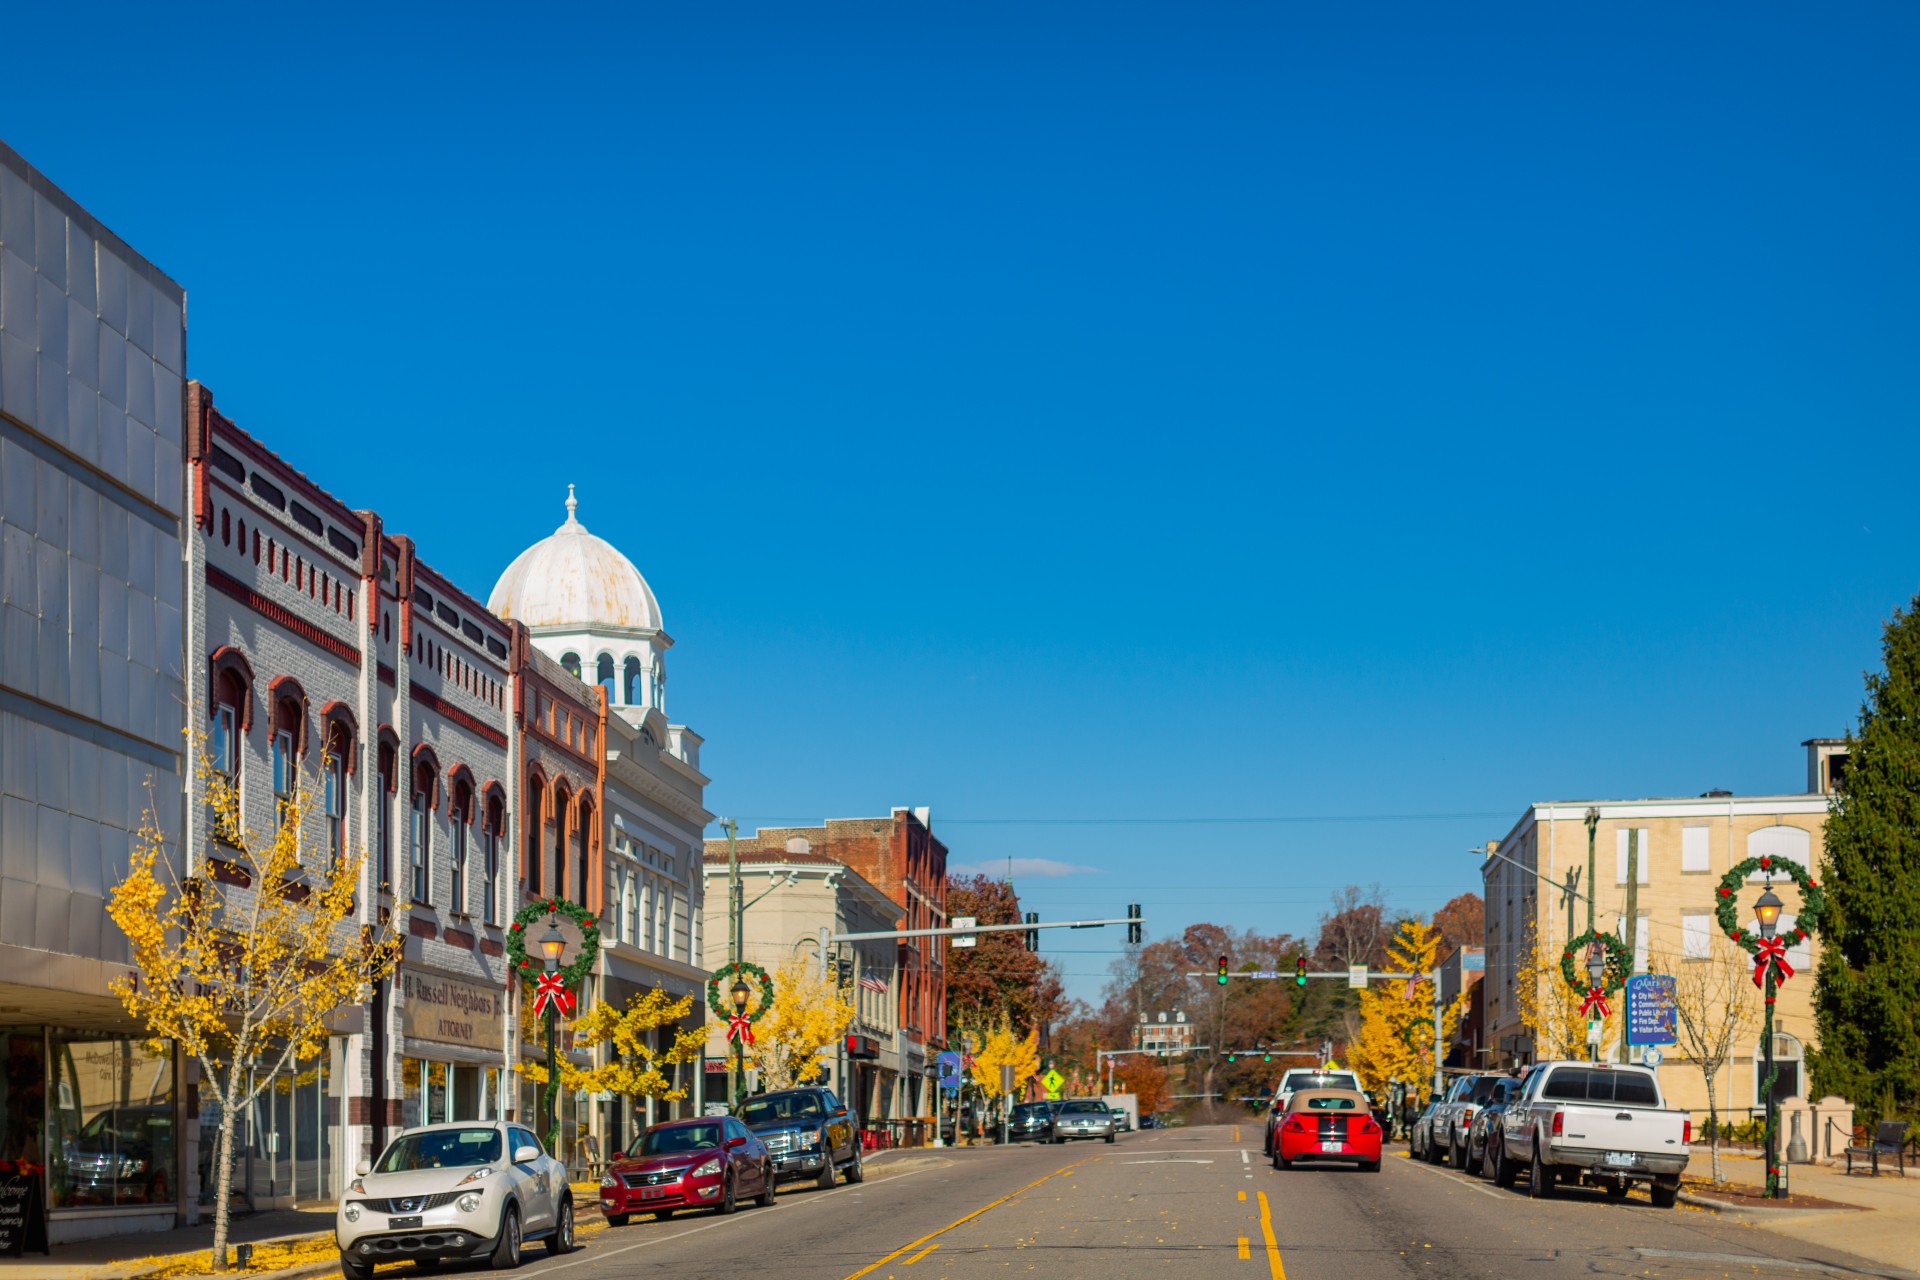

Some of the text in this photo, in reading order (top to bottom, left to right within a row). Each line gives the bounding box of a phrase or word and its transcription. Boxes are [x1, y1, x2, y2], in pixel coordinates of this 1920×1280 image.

[404, 975, 502, 1021] H. Russell Neighbors Jr.
[1638, 992, 1648, 1001] City
[1638, 1009, 1653, 1017] Public
[1648, 1017, 1659, 1026] Dept.
[438, 1019, 473, 1040] ATTORNEY
[1638, 1026, 1654, 1034] Visitor
